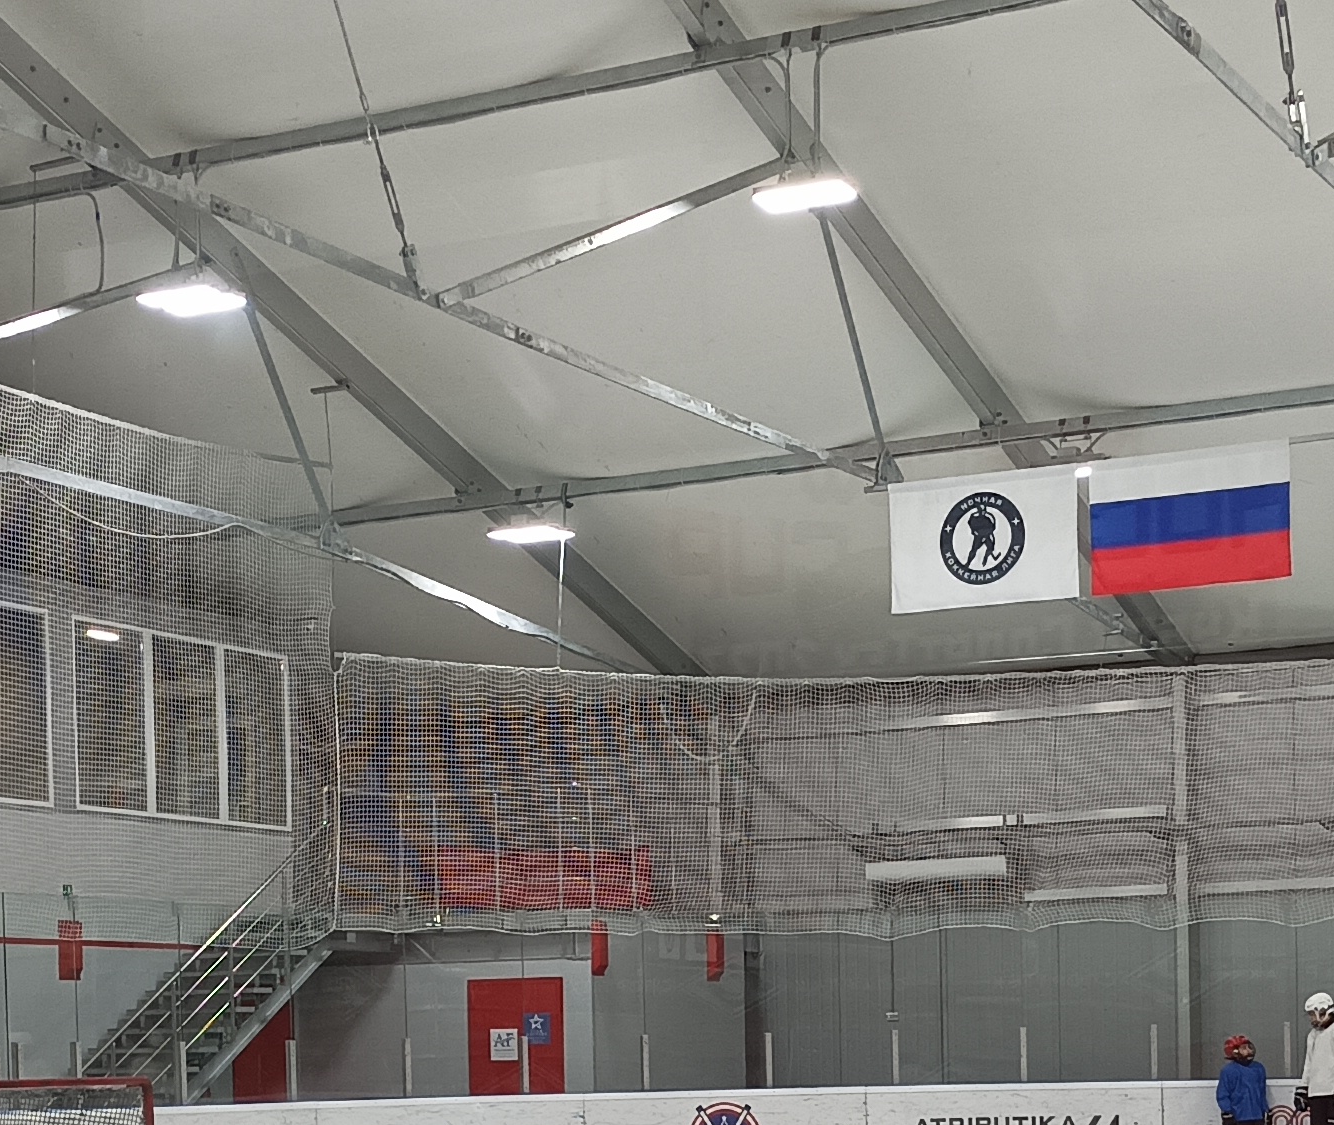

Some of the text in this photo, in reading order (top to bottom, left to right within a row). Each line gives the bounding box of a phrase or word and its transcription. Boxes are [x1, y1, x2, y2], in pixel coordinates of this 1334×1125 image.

[960, 496, 1003, 511] НОЧНАЯ
[945, 545, 1020, 581] ХОККЕЙНАЯ ЛИГА
